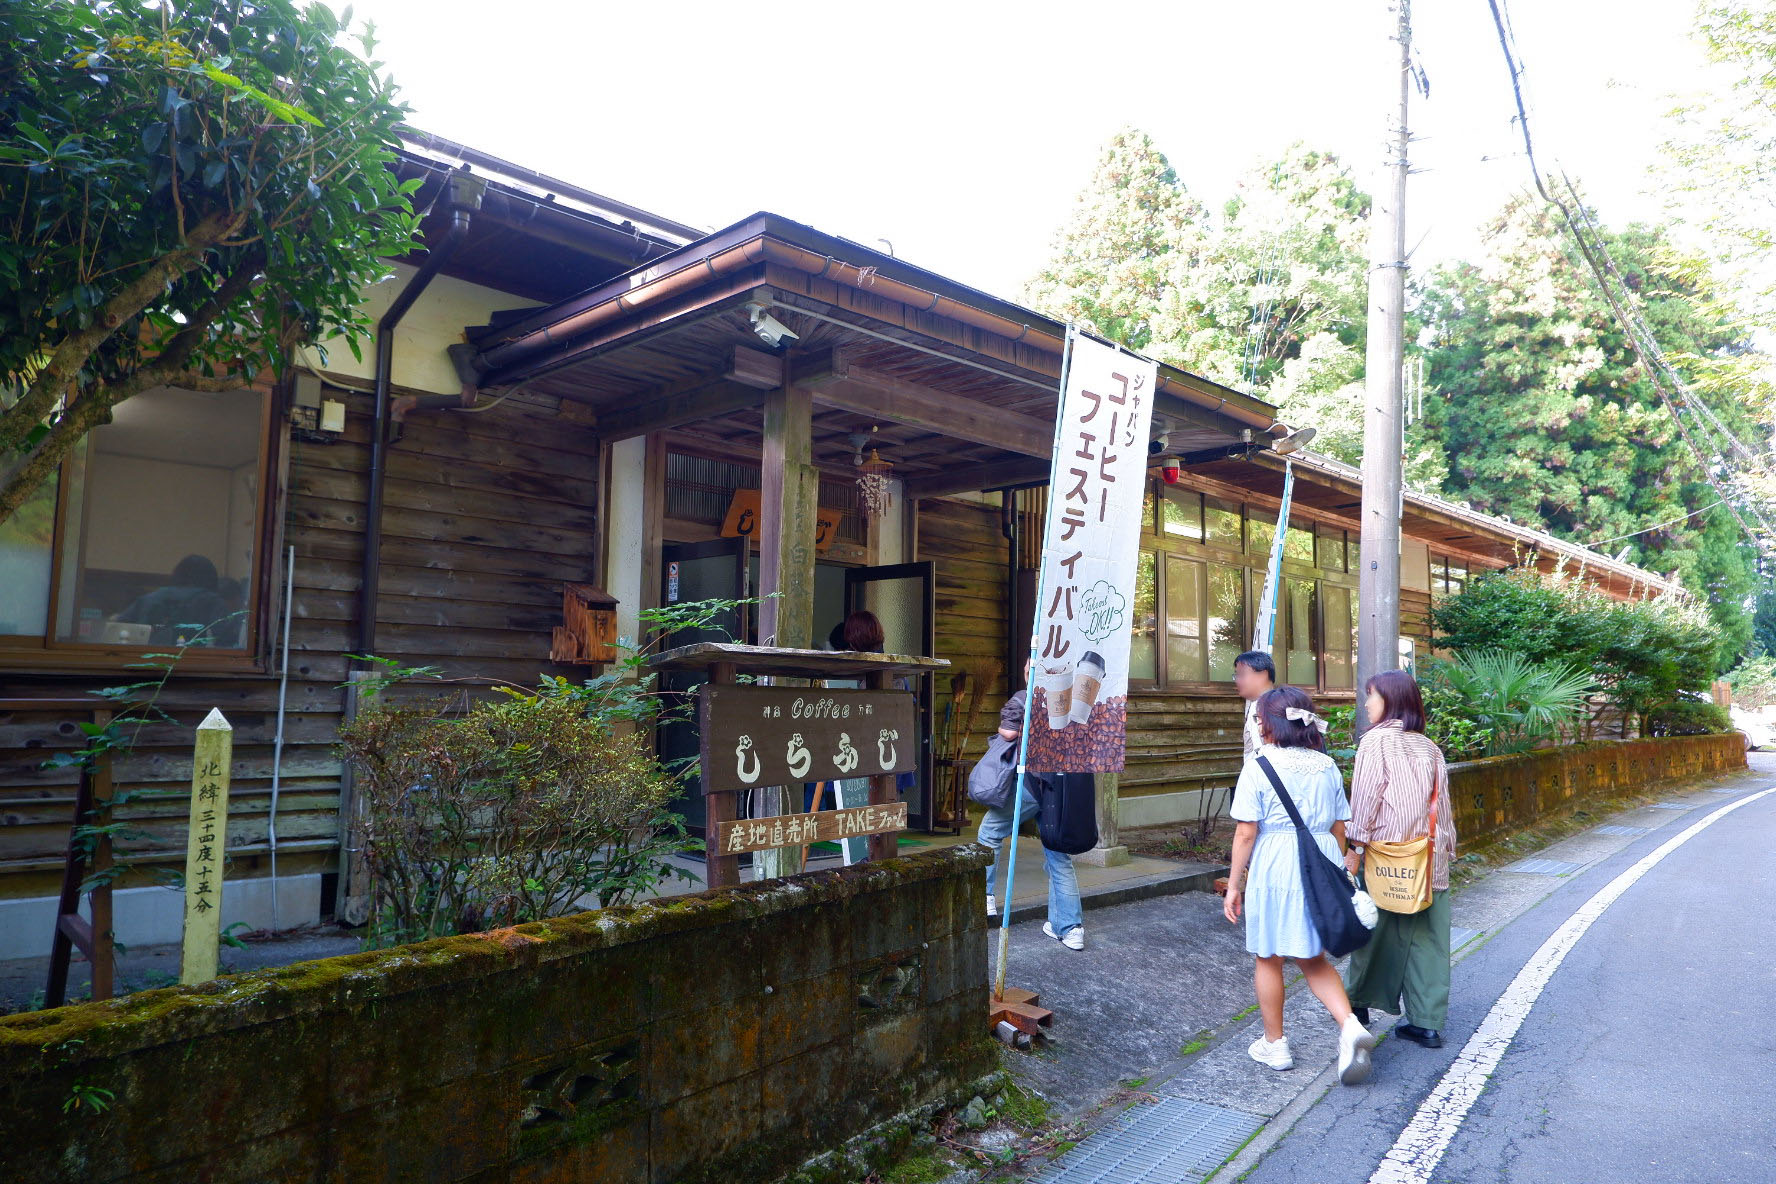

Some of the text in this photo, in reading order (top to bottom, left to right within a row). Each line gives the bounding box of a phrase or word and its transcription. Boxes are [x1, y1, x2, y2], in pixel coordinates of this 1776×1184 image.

[1099, 371, 1129, 523] コーヒー
[1124, 373, 1146, 448] ジャパン
[1041, 388, 1103, 659] フェスティバル
[791, 697, 851, 719] Coffee
[735, 728, 899, 784] しらふじ
[193, 761, 222, 914] 北緯三十四度十五分
[727, 815, 819, 853] 産地直売所
[835, 807, 876, 836] TAKE
